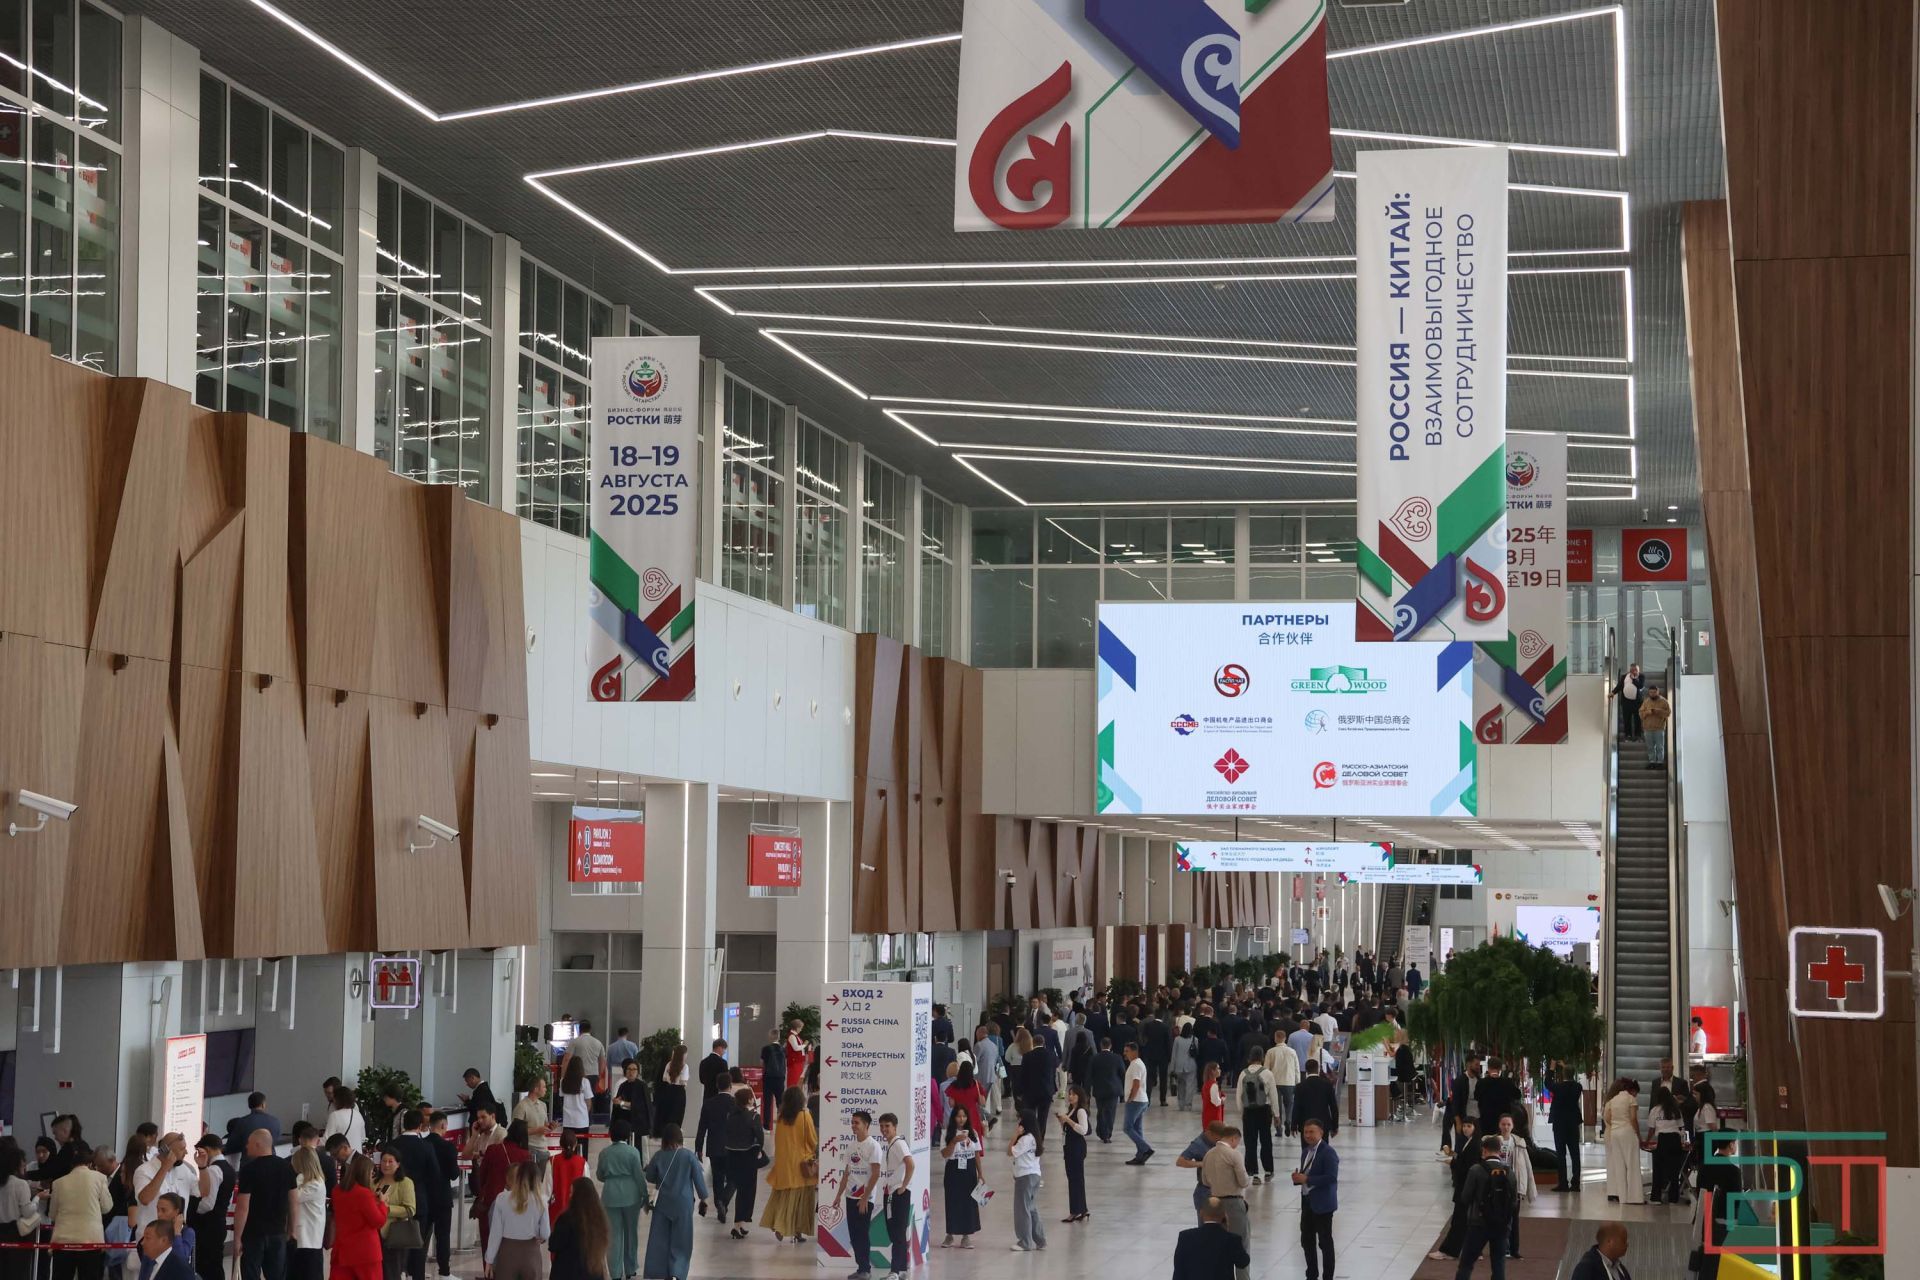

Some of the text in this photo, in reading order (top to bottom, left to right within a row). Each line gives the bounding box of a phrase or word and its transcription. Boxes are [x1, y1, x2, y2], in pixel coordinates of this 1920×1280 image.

[1384, 192, 1411, 298] КИТАЙ:
[1425, 206, 1446, 446] ВЗАИМОВЫГОДНОЕ
[1456, 214, 1476, 438] СОТРУДНИЧЕСТВО
[1390, 343, 1410, 461] РОССИЯ
[608, 414, 682, 425] РОСТКИ 萌芽
[609, 446, 680, 466] 18–19
[600, 474, 688, 488] АВГУСТА
[609, 494, 678, 516] 2025
[1242, 615, 1329, 626] ПАРТНЕРЫ
[1258, 632, 1313, 646] 合作伙伴
[1338, 715, 1410, 724] 俄罗斯中国总商会
[842, 990, 874, 999] ВХОД
[842, 1001, 861, 1011] 入口
